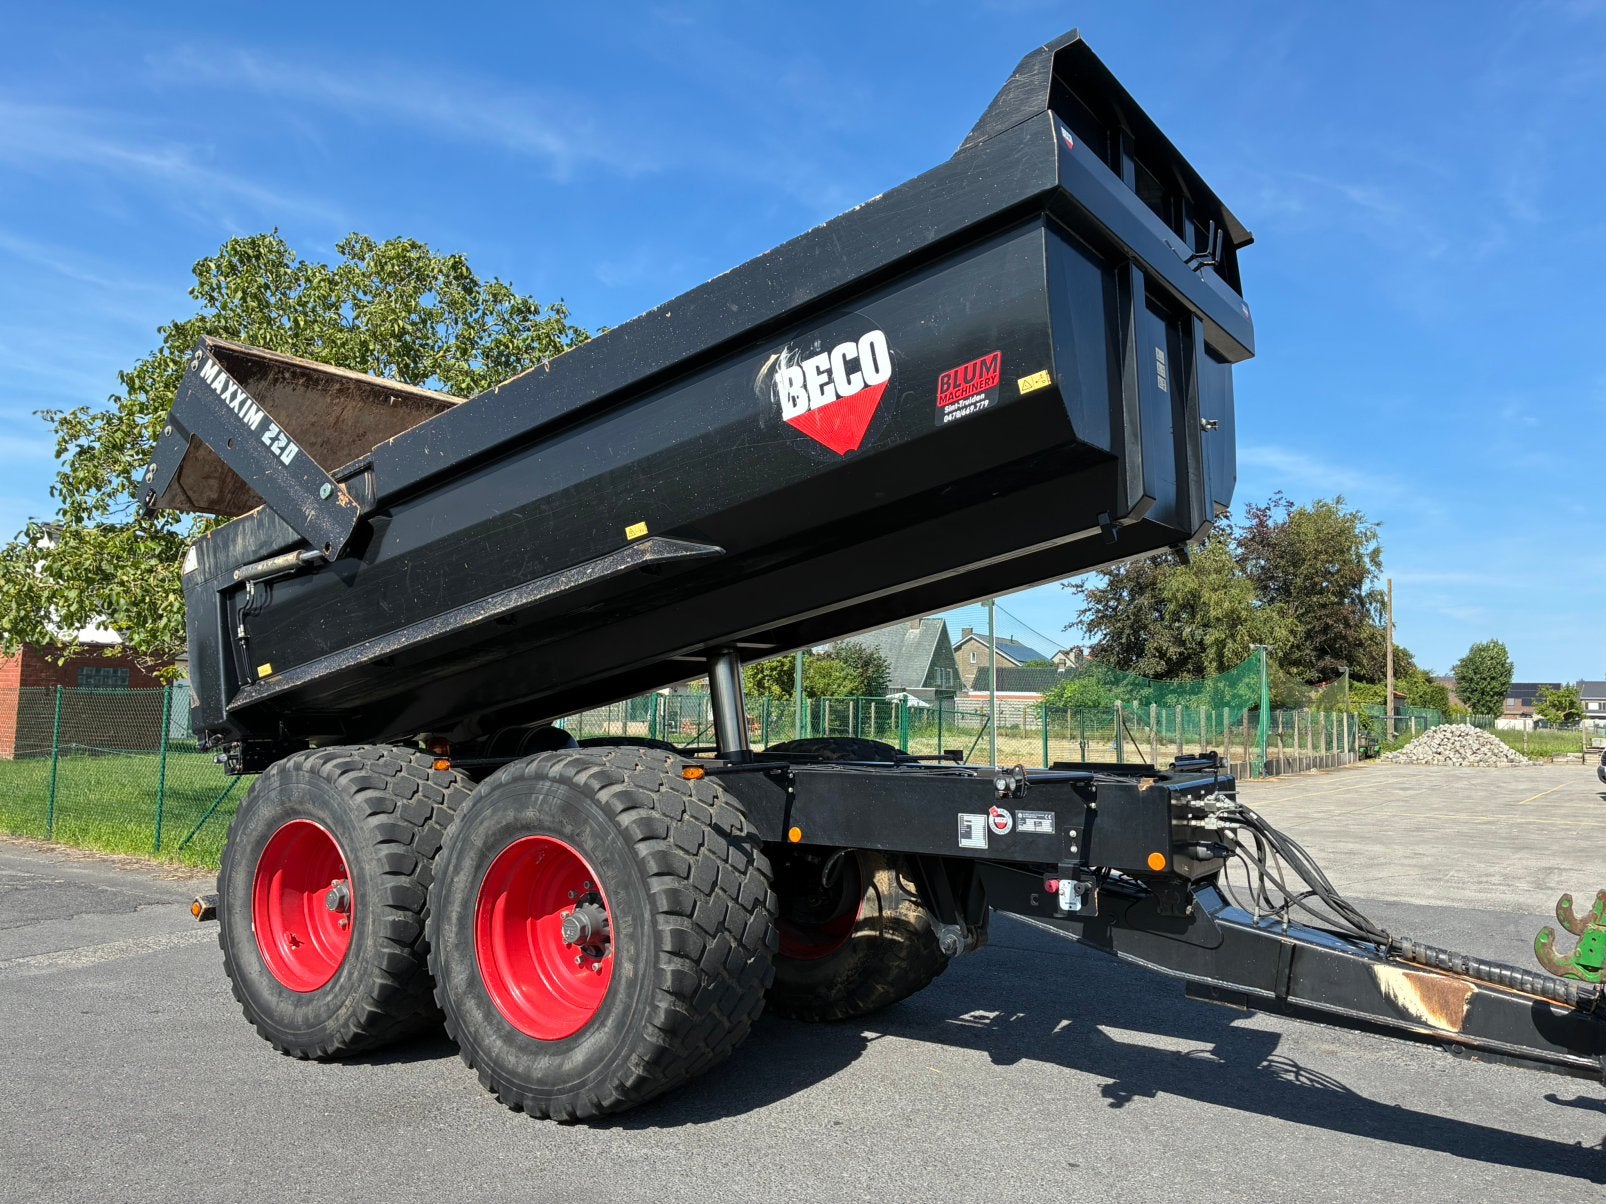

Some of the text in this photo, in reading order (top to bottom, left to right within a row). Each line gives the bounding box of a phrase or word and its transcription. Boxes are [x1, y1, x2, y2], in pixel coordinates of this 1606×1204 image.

[777, 329, 892, 421] BECO
[940, 353, 998, 394] BLUM
[940, 374, 998, 405] MACHINERY
[200, 358, 299, 466] MAXXIM 220
